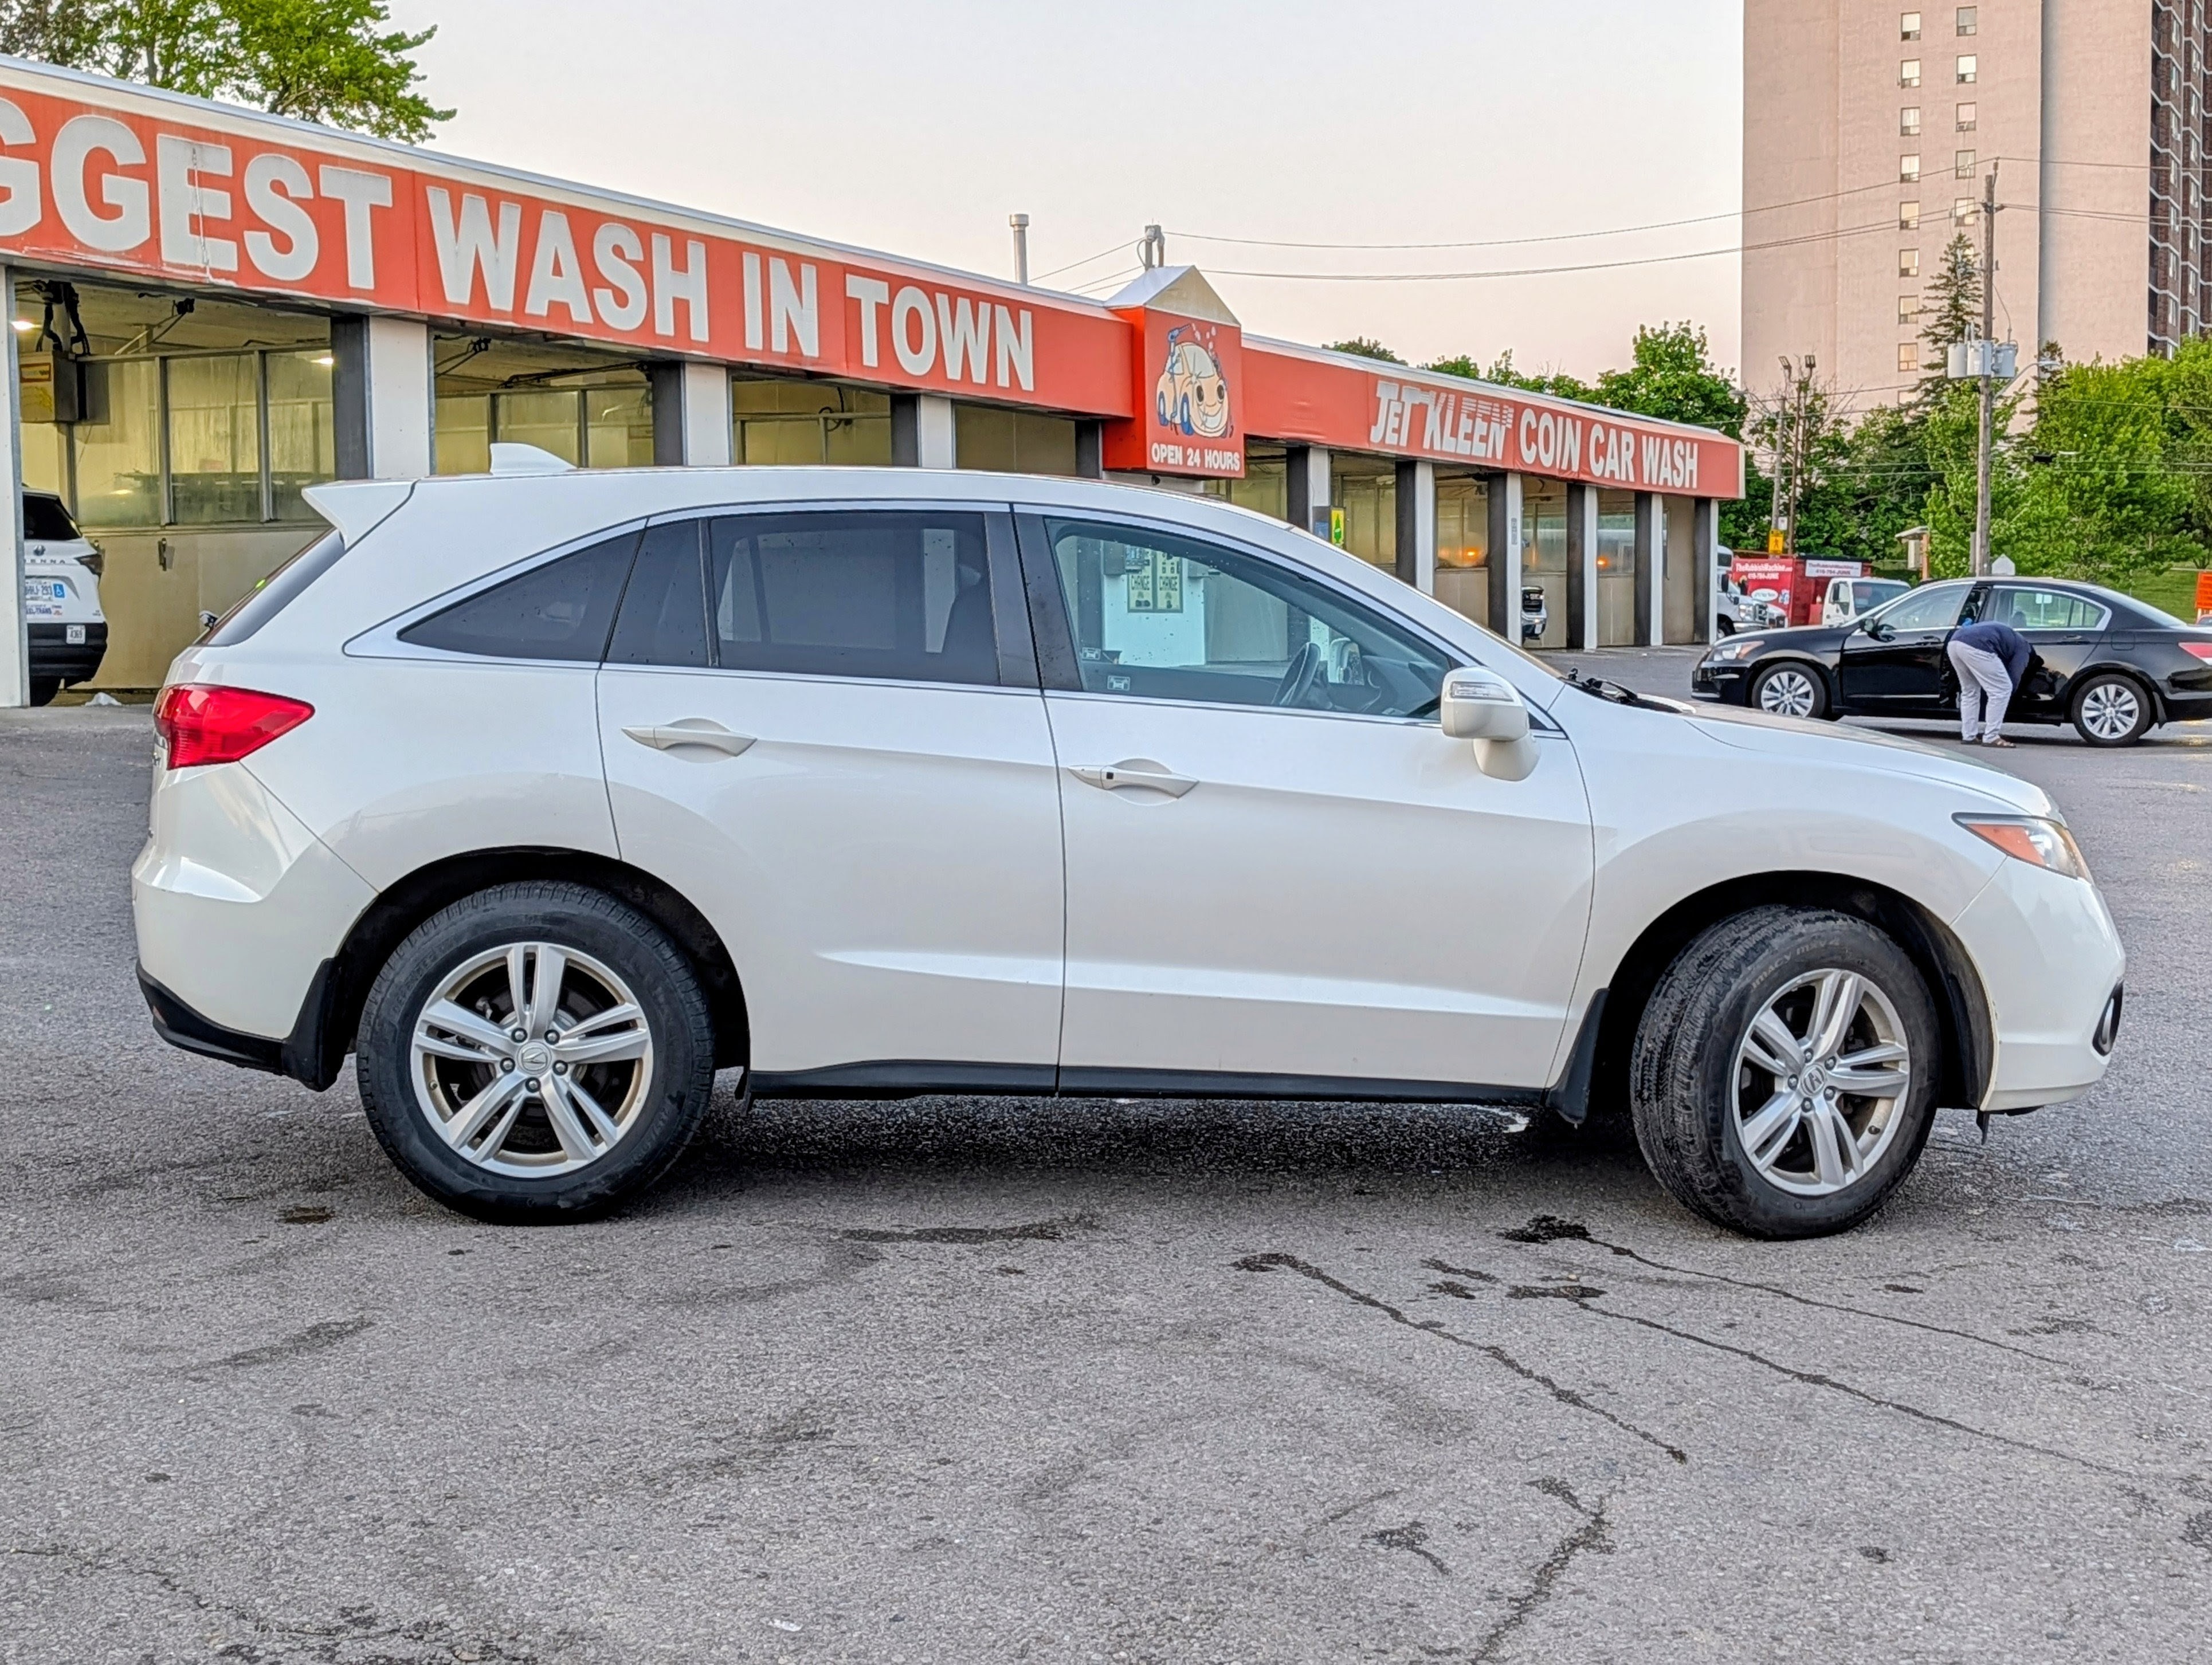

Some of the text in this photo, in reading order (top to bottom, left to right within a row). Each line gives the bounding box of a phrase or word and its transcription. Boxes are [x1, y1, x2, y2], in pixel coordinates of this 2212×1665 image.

[426, 186, 709, 343] WASH
[743, 252, 819, 358] IN
[845, 274, 1035, 392] TOWN
[1151, 442, 1241, 472] OPEN 24 HOURS
[1370, 380, 1699, 489] JET KLEEN COIN CAR WASH
